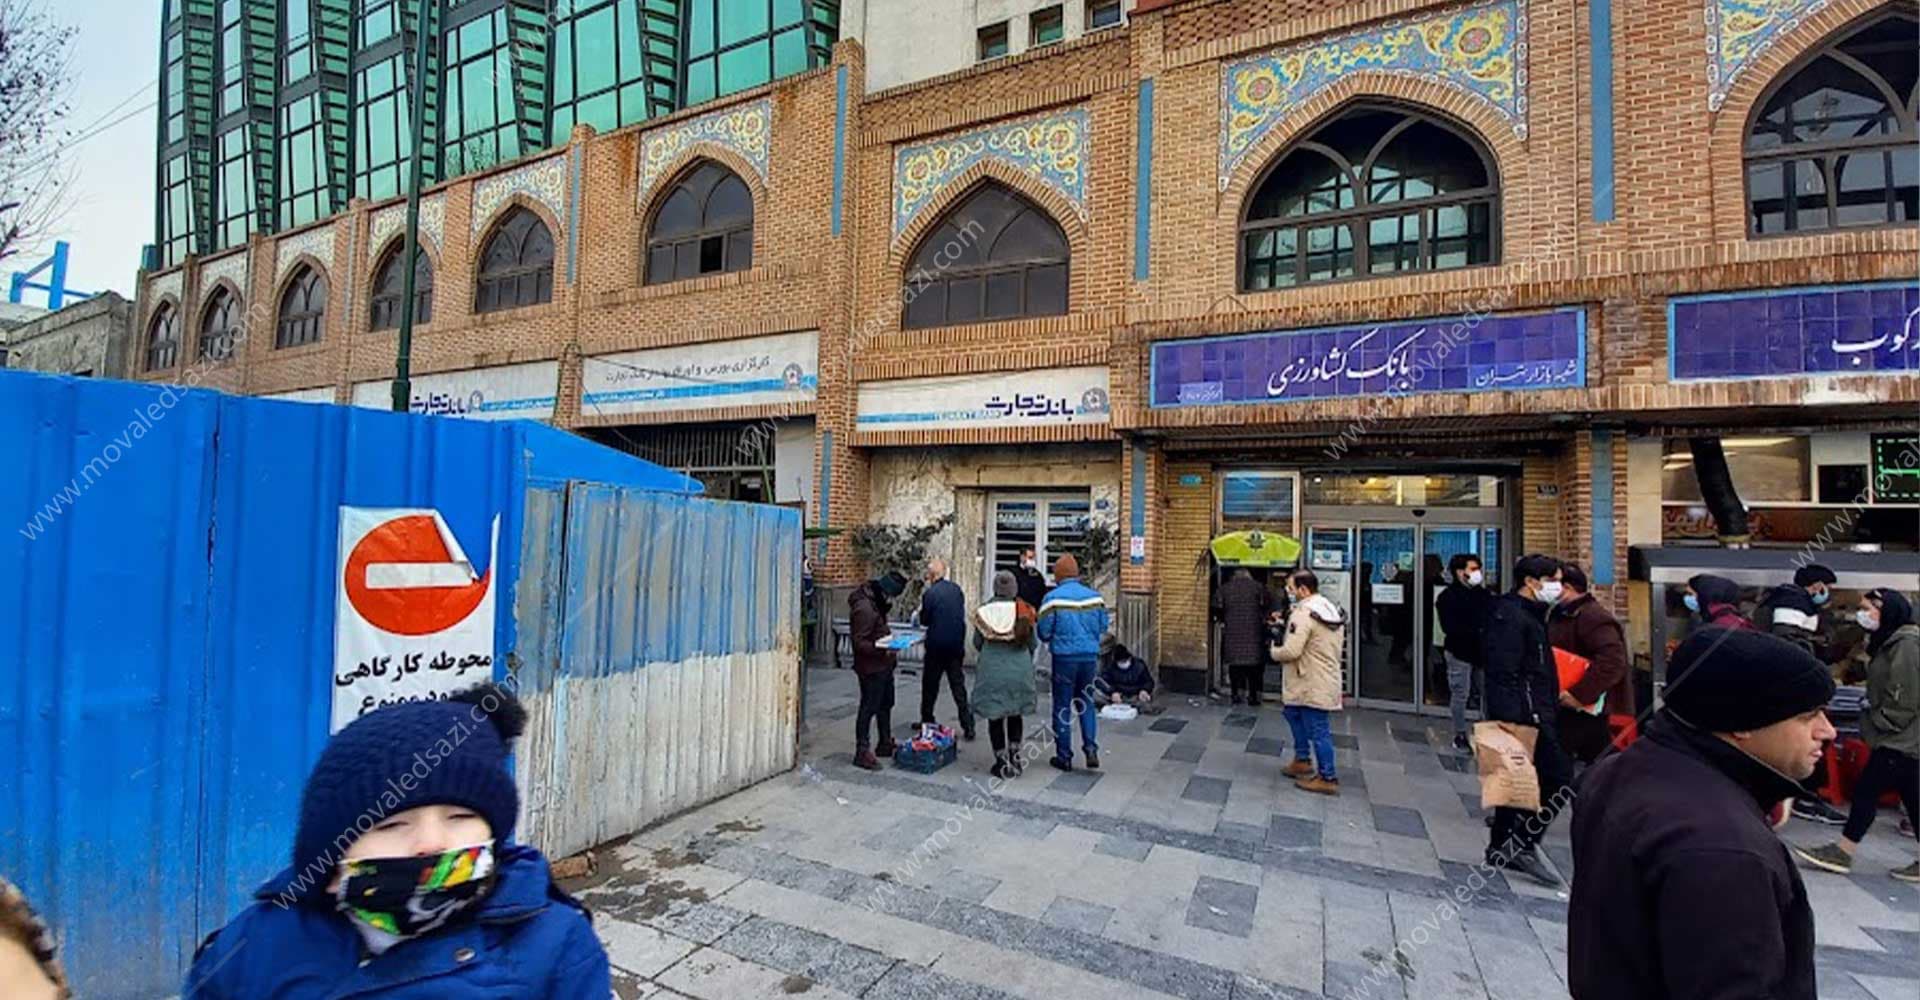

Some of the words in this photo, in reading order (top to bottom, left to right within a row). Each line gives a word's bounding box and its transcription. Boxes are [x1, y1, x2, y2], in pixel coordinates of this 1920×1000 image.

[1267, 328, 1379, 396] کشاورزی
[1346, 328, 1426, 388] بانک
[1475, 364, 1529, 387] تهران
[1526, 365, 1553, 385] بازار
[984, 393, 1046, 416] تجارت
[1026, 397, 1074, 422] بانک
[335, 652, 424, 686] کارگاهی
[429, 649, 493, 675] محوطه
